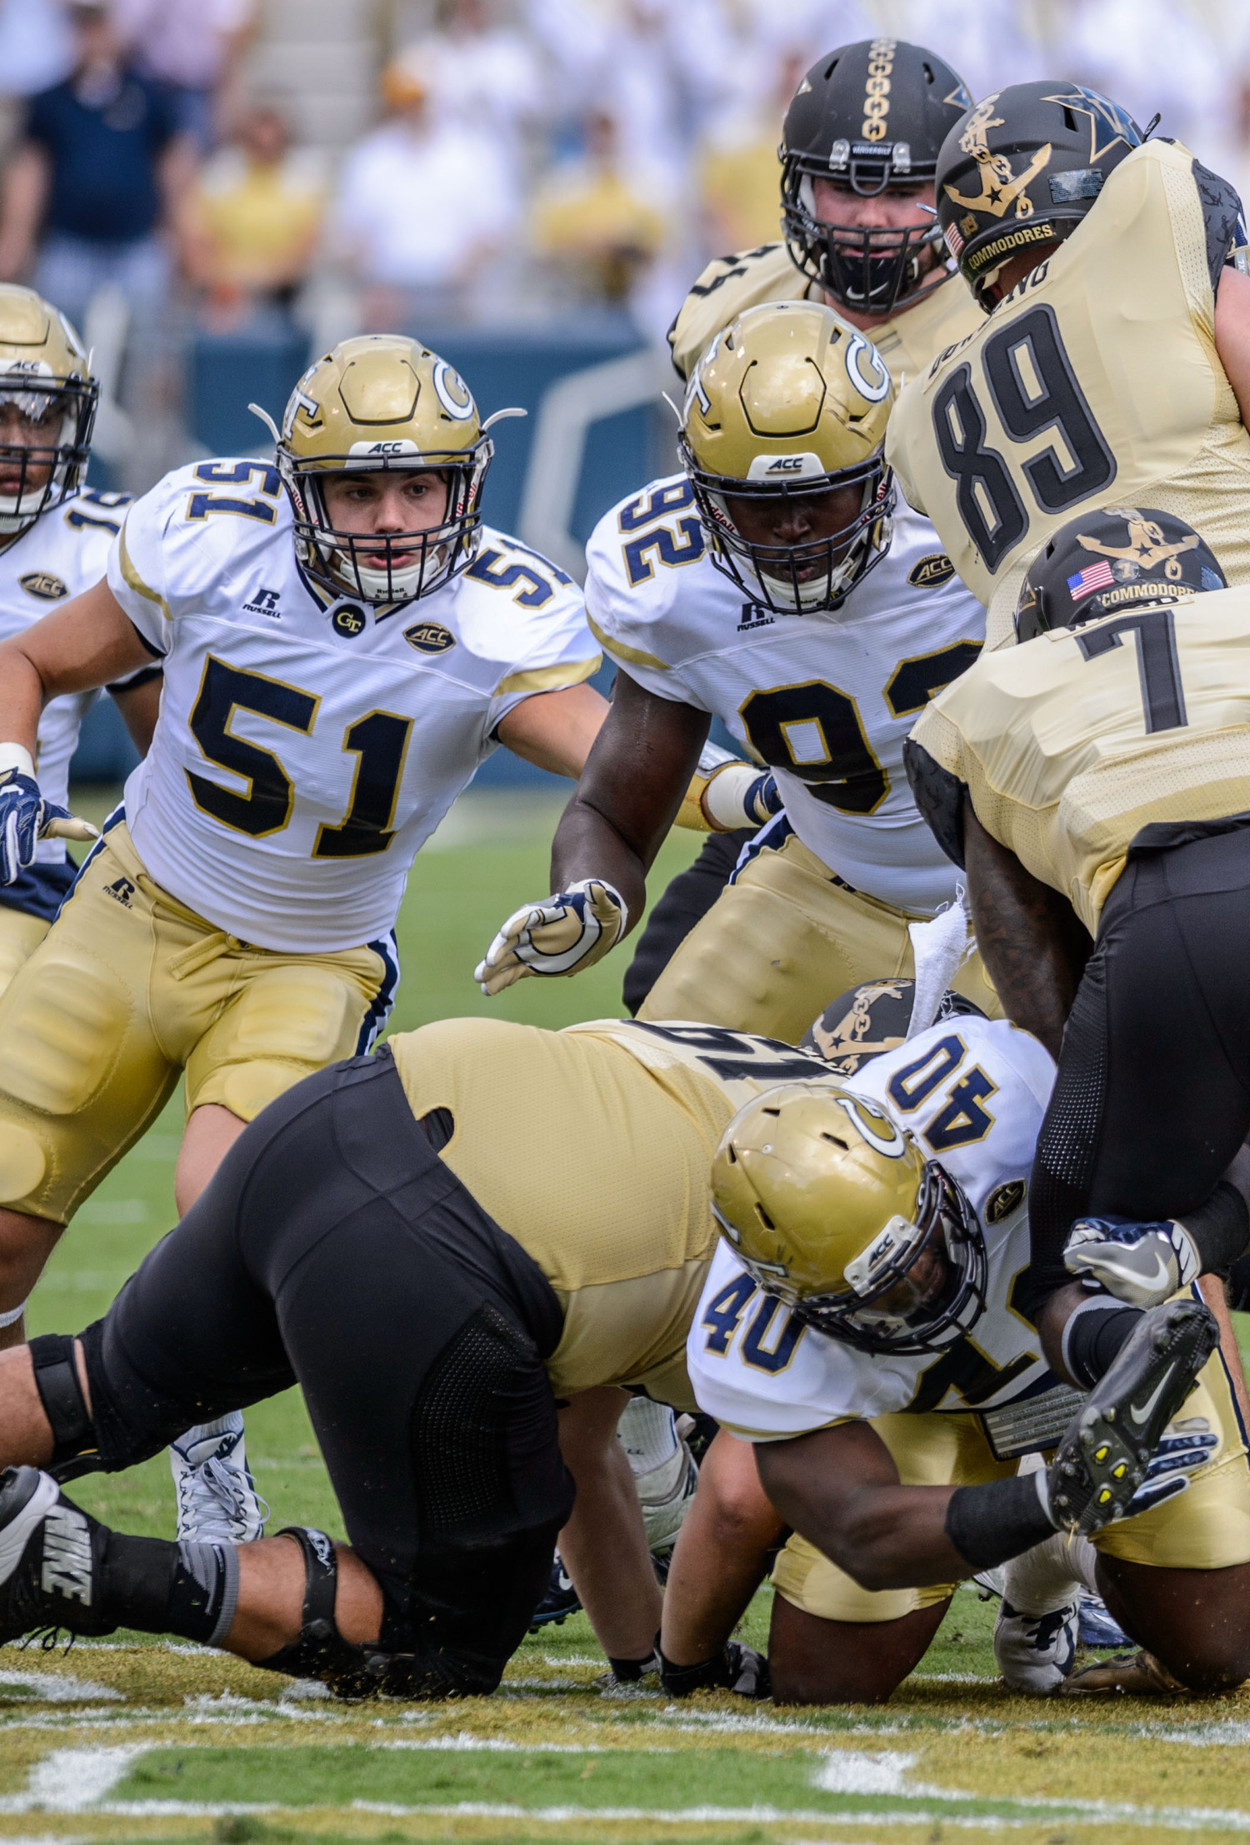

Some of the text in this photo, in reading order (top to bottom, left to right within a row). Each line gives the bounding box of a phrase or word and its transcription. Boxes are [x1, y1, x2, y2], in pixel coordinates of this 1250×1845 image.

[968, 224, 1054, 270] COMMODORES
[9, 361, 41, 371] ACC
[367, 442, 404, 454] ACC
[931, 303, 1117, 575] 89
[768, 457, 804, 470] ACC
[185, 461, 283, 526] 51
[617, 478, 707, 589] 92
[462, 536, 577, 610] 51
[917, 559, 954, 581] ACC
[242, 604, 281, 619] RUSSELL
[337, 612, 362, 633] GT
[737, 617, 776, 632] RUSSELL
[411, 627, 451, 644] ACC
[1073, 608, 1188, 735] 7
[184, 652, 415, 859] 51
[102, 885, 134, 910] RUSSELL
[885, 1032, 1000, 1153] 40
[993, 1186, 1019, 1216] ACC
[867, 1232, 895, 1268] ACC
[701, 1271, 809, 1377] 40
[41, 1504, 92, 1607] NIKE
